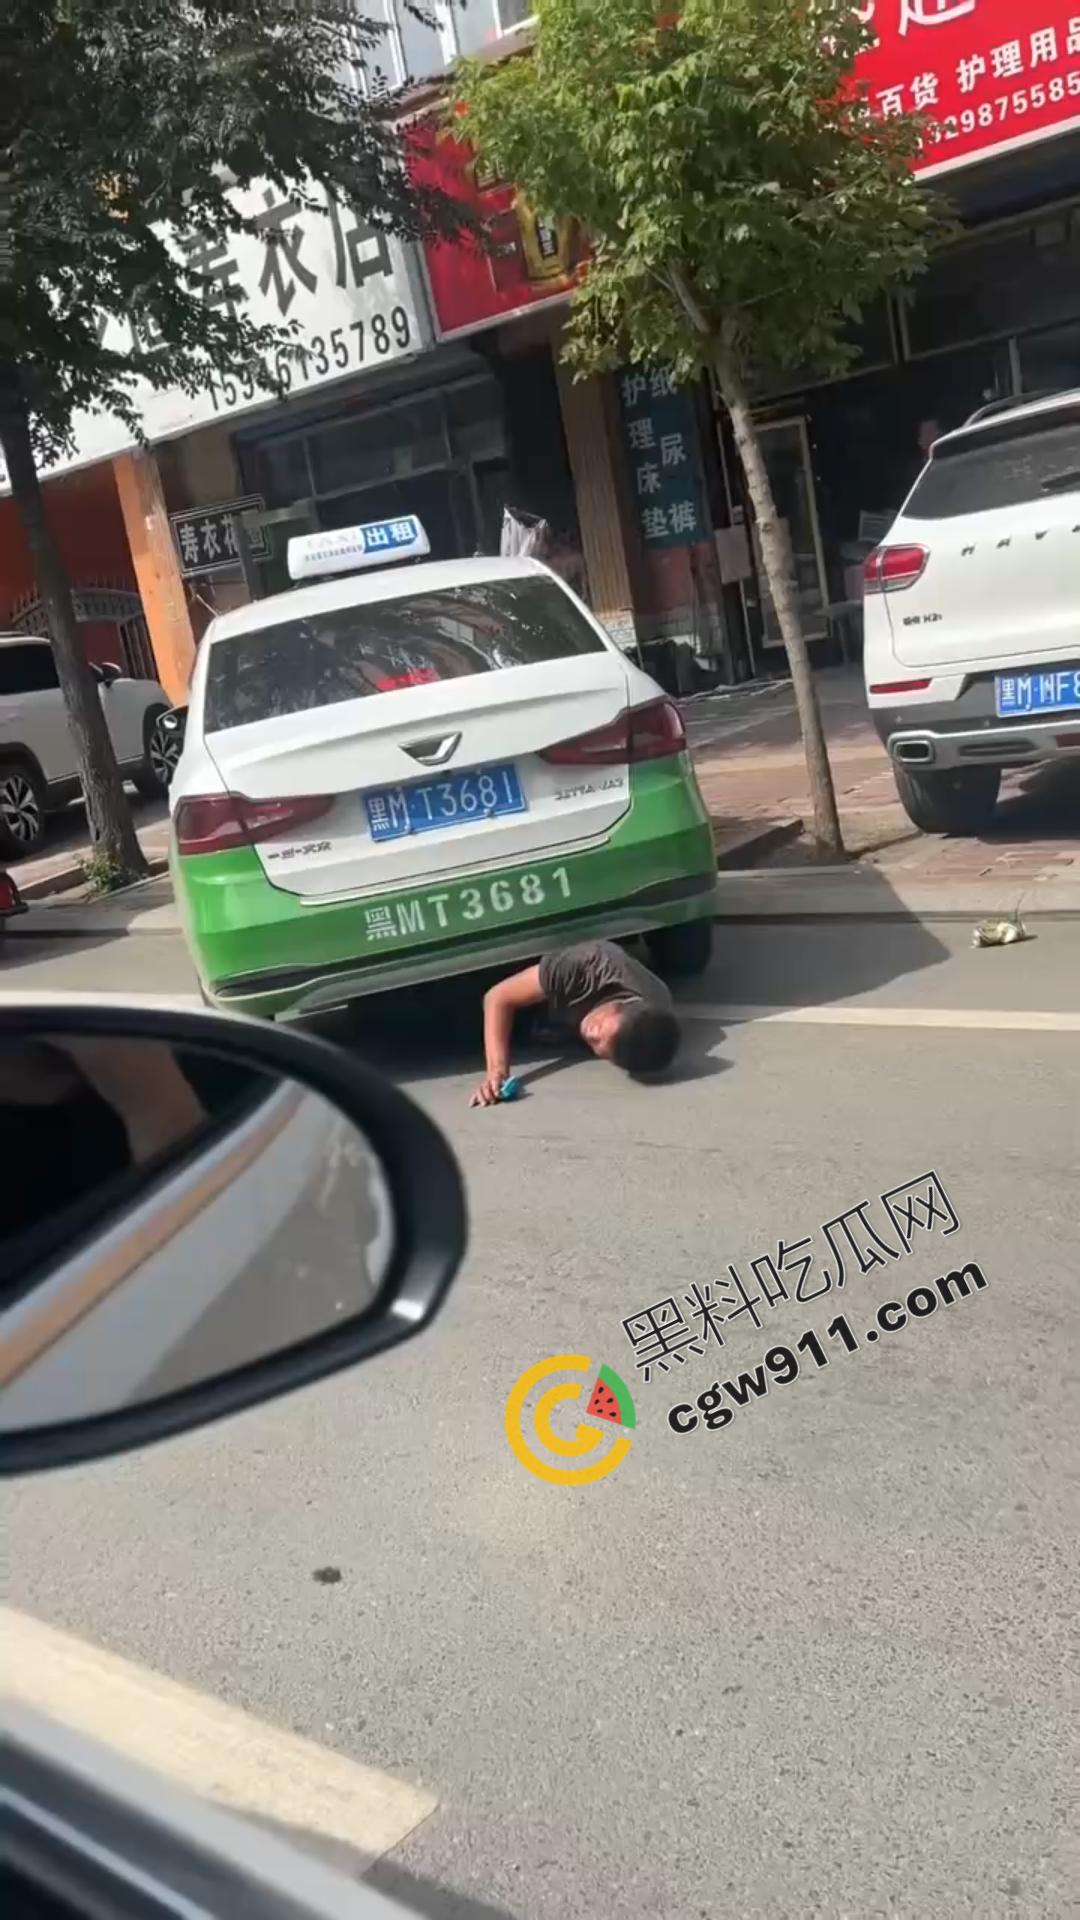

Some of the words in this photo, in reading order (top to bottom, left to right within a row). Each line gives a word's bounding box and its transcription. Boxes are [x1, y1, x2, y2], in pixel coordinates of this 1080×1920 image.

[848, 72, 939, 121] 百货
[204, 306, 411, 411] 1596135789
[622, 375, 670, 539] 护理床垫
[367, 522, 415, 547] 出租
[364, 865, 573, 941] 黑MT3681
